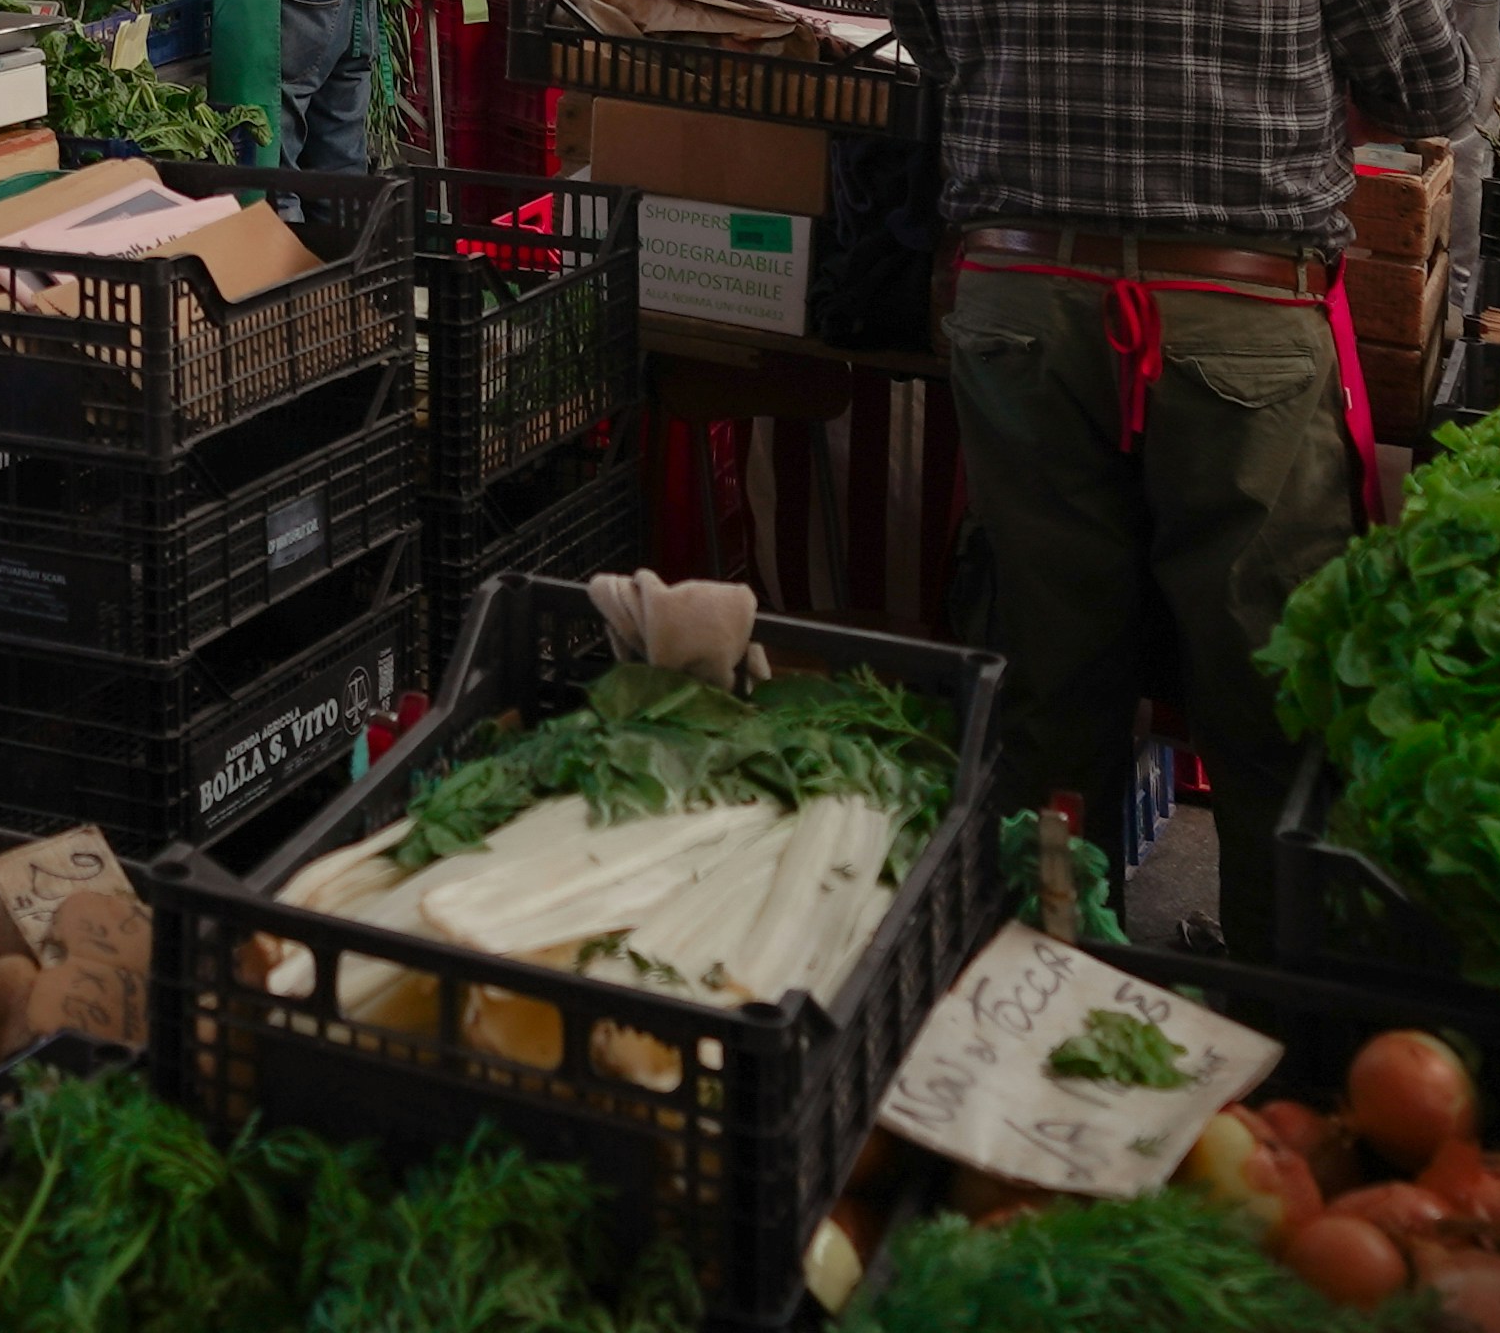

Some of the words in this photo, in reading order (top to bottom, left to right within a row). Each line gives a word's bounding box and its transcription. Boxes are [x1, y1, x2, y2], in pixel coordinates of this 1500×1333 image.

[644, 204, 731, 231] SHOPPERS
[640, 261, 784, 302] COMPOSTABILE
[670, 291, 713, 309] NORMA
[199, 746, 267, 814] BOLLA
[268, 733, 288, 766] S.
[290, 697, 339, 749] VITO
[225, 731, 262, 764] AZIENDA
[260, 706, 301, 741] AGRICOLA
